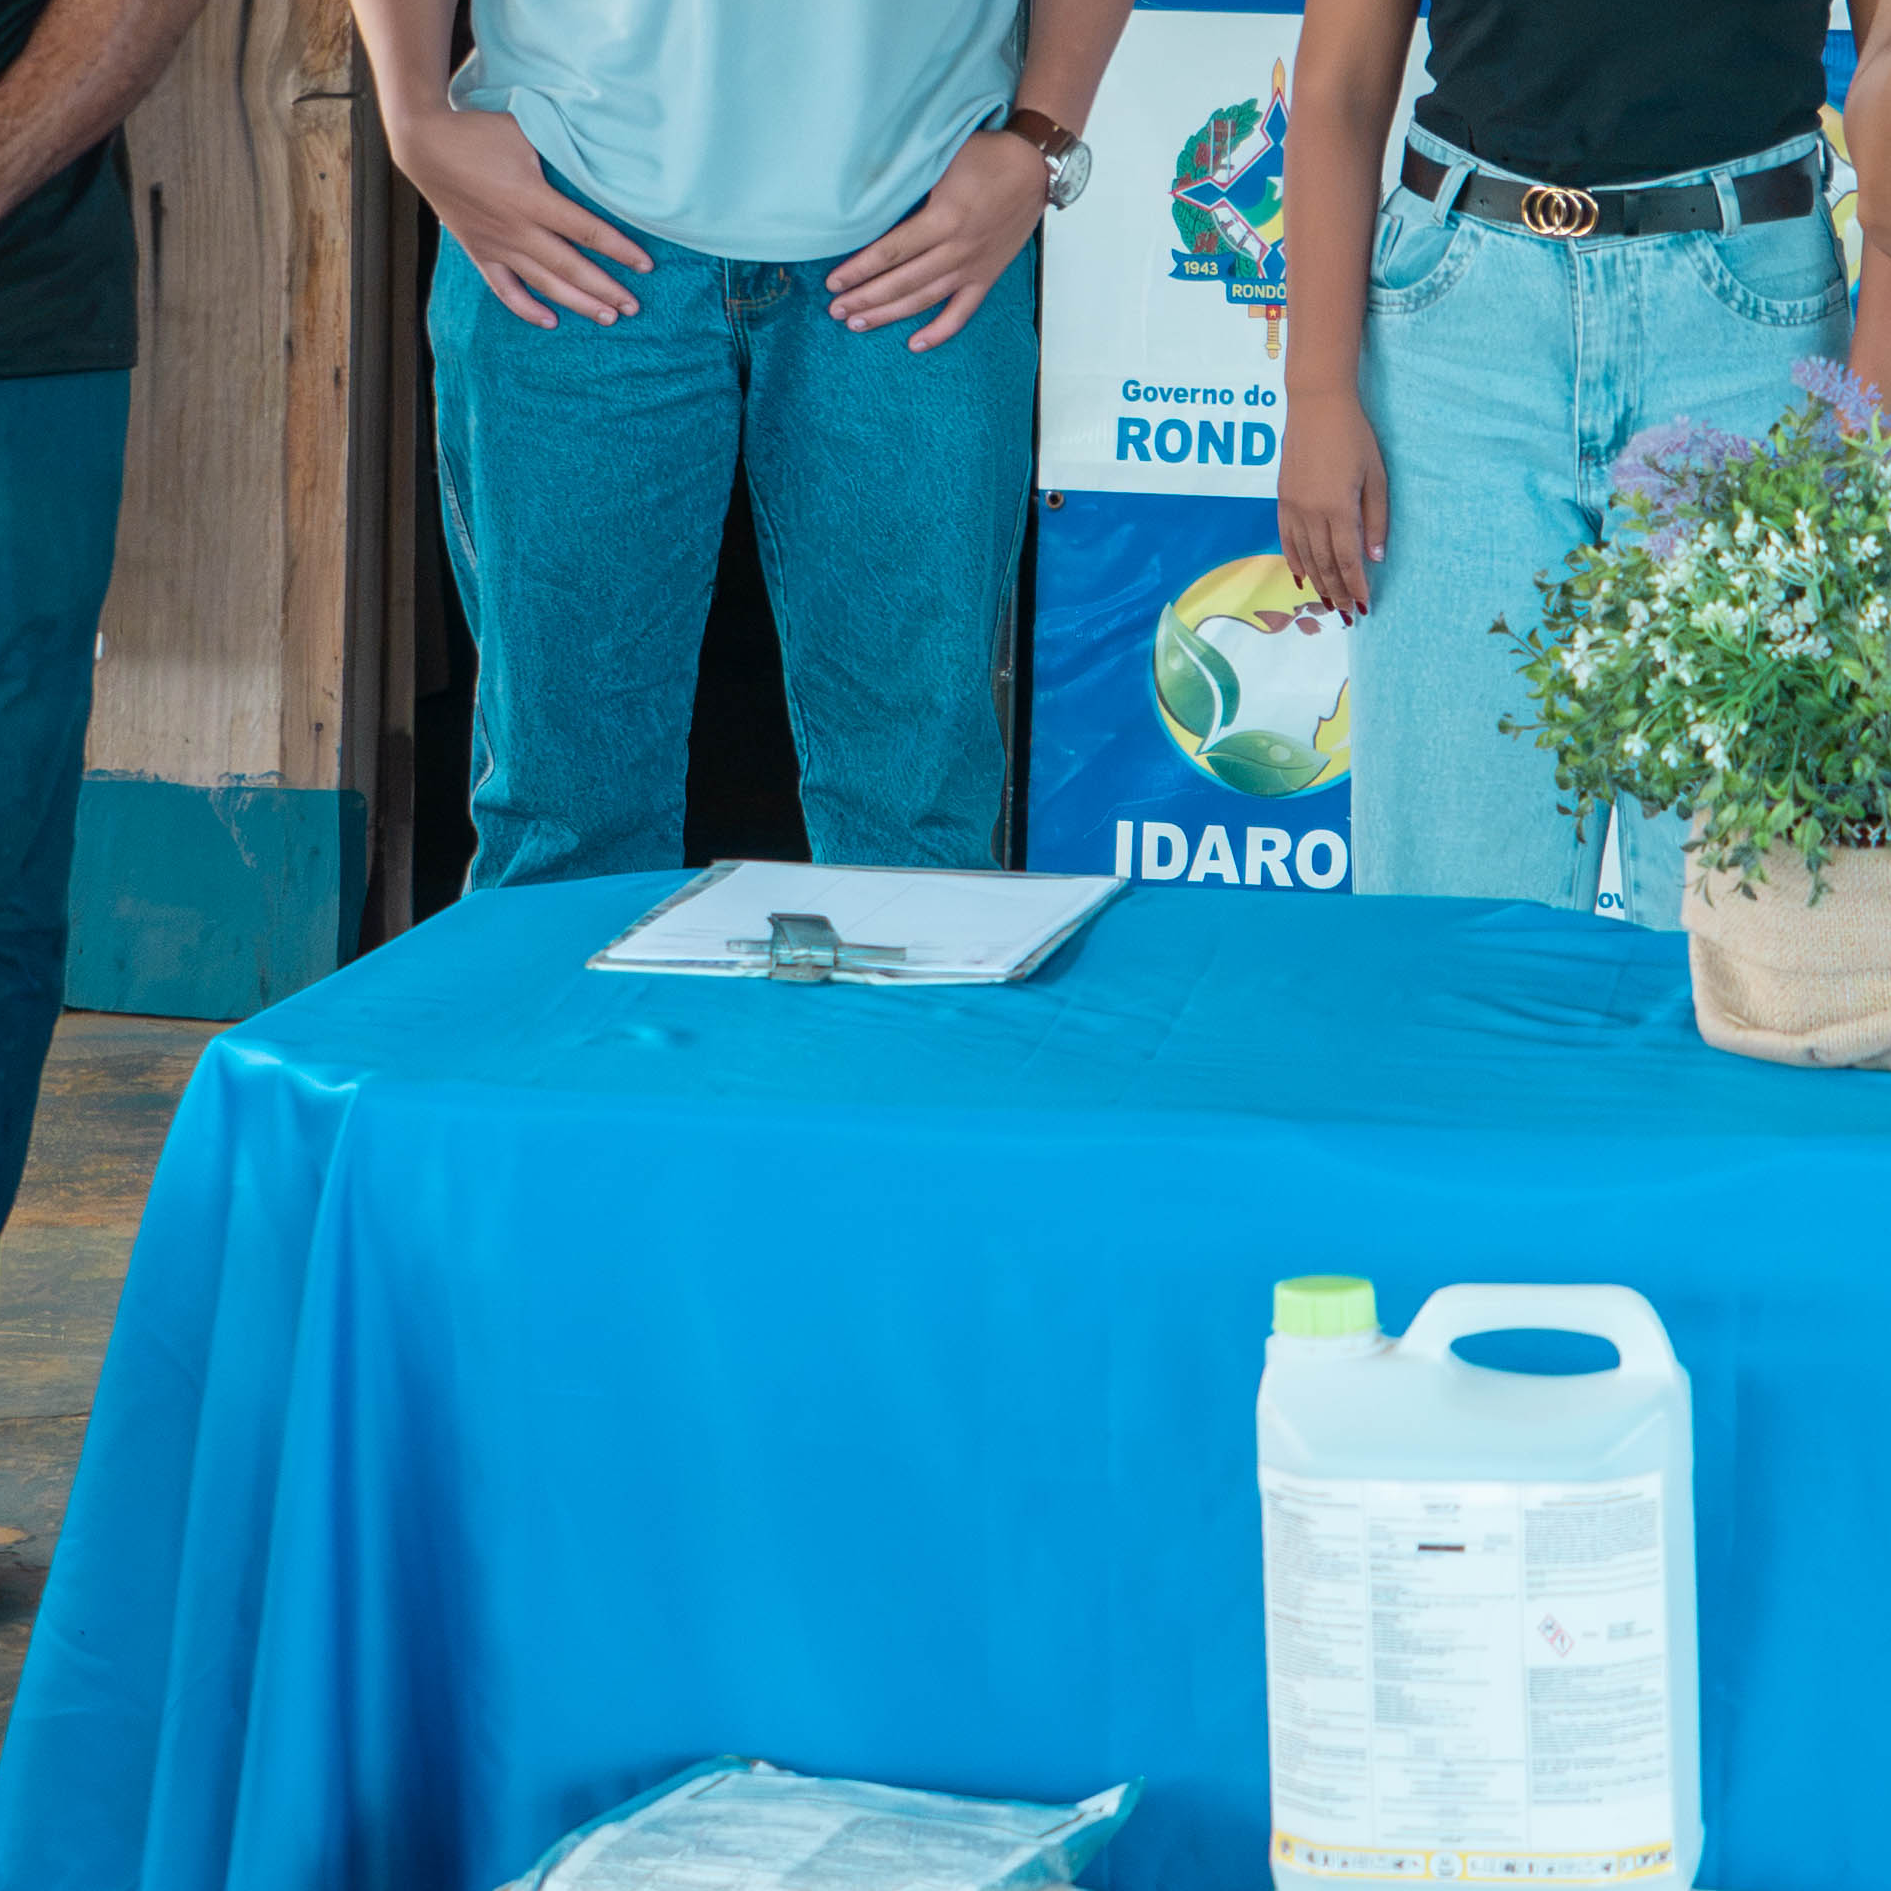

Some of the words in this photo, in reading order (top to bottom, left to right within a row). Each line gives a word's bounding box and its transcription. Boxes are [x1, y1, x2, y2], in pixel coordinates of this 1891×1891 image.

[1183, 259, 1219, 275] 1943
[1231, 280, 1287, 300] RONDÔ
[1122, 379, 1235, 406] Governo
[1243, 383, 1277, 407] do
[1116, 415, 1277, 466] ROND
[1115, 819, 1348, 890] IDARO
